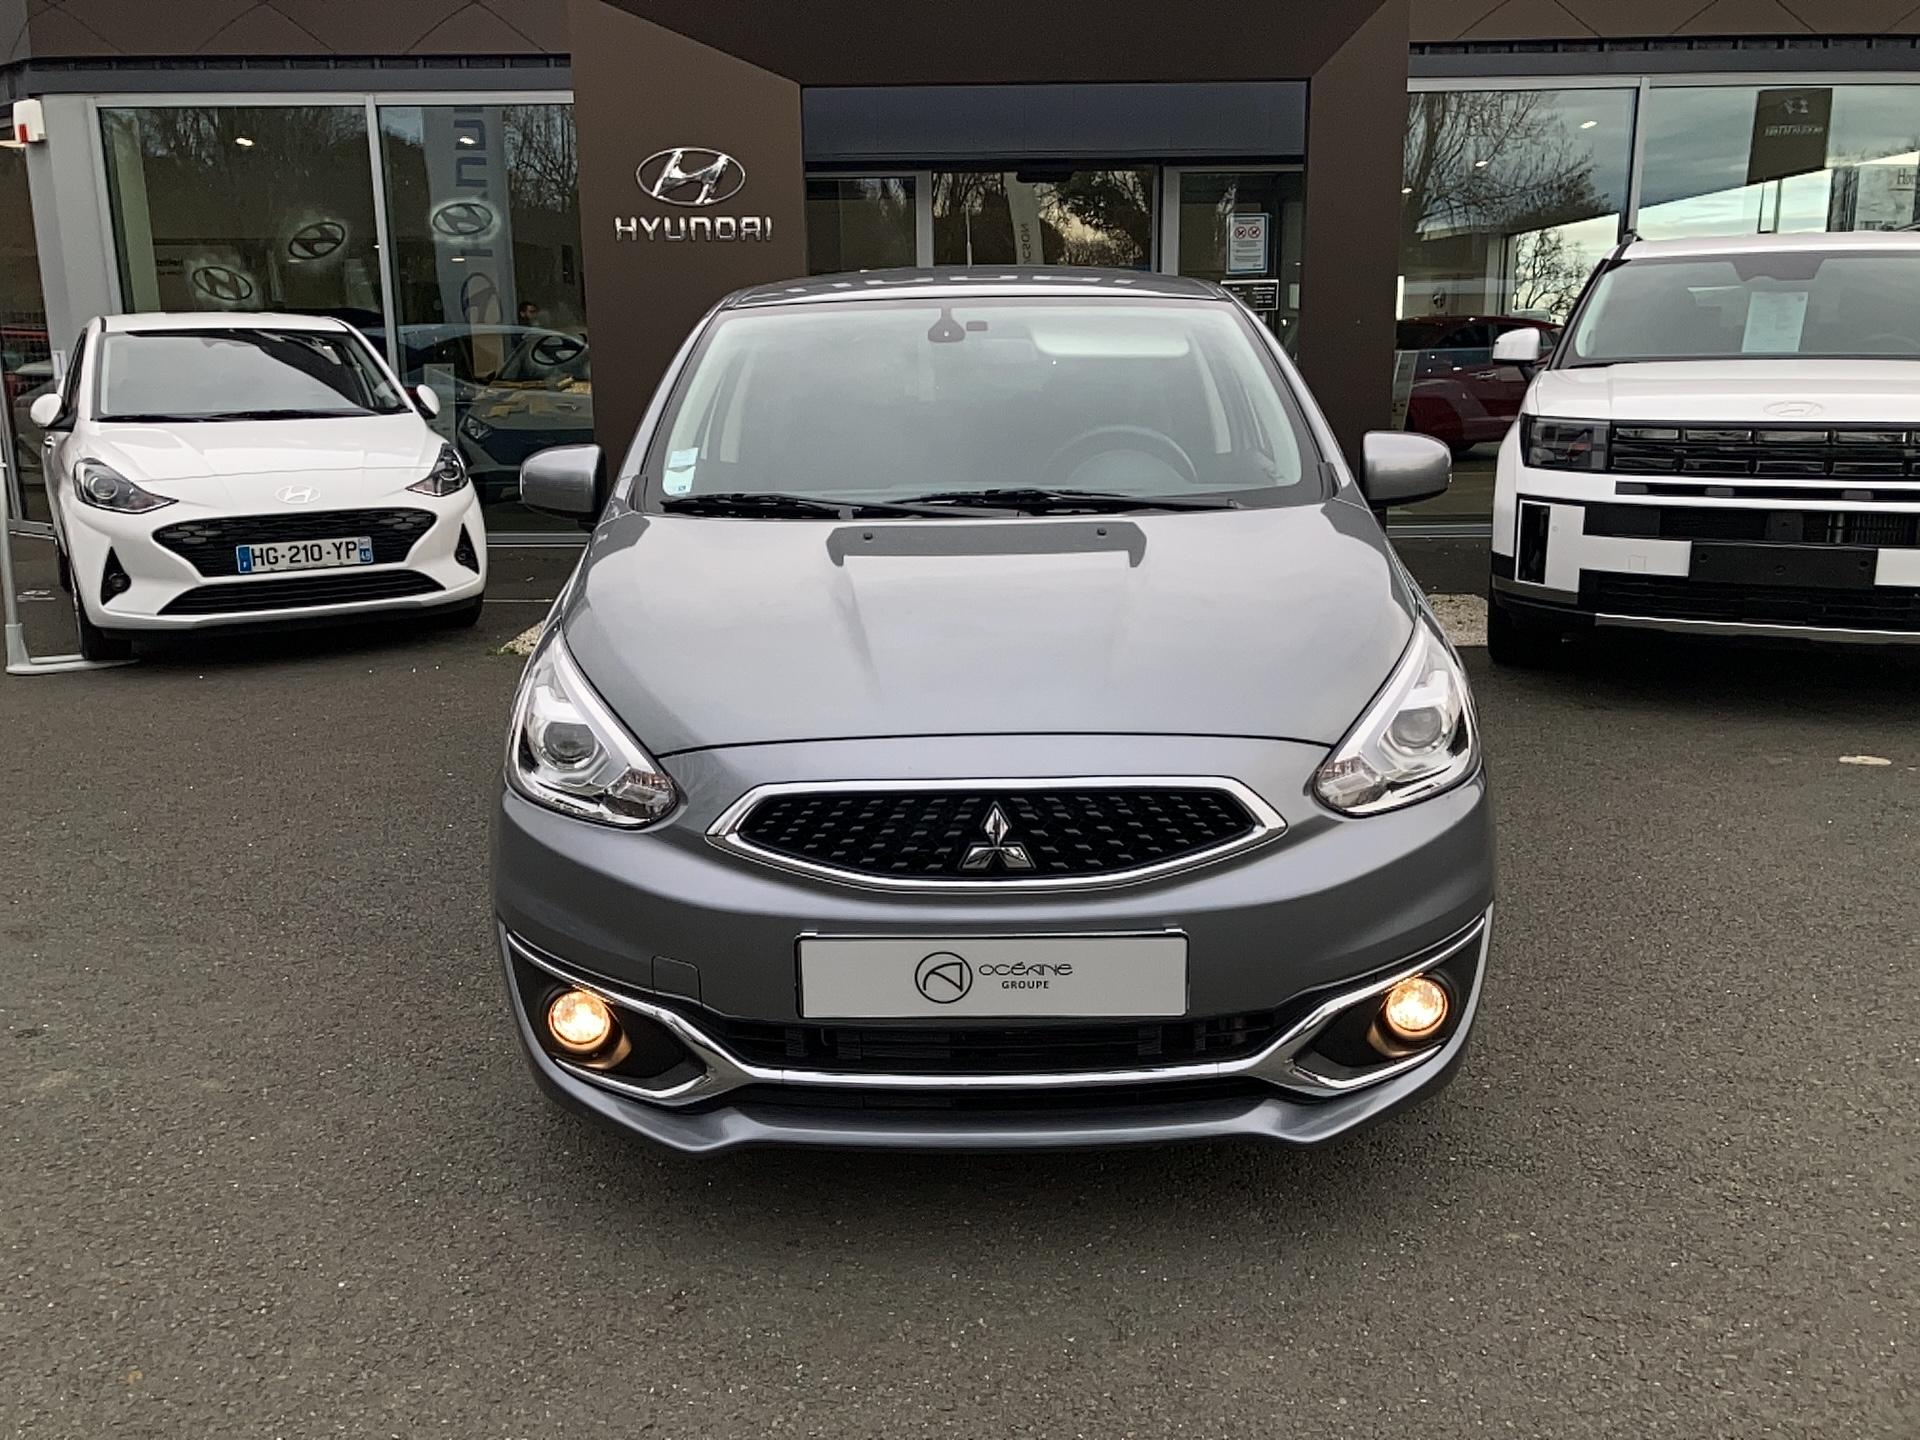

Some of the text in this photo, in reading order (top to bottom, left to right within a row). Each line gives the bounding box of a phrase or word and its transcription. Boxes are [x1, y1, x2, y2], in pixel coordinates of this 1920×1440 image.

[614, 216, 773, 242] HYUNDAI
[251, 541, 357, 566] HG-210-YP
[978, 961, 1074, 976] OCÉANE
[1001, 980, 1050, 990] GROUPE
